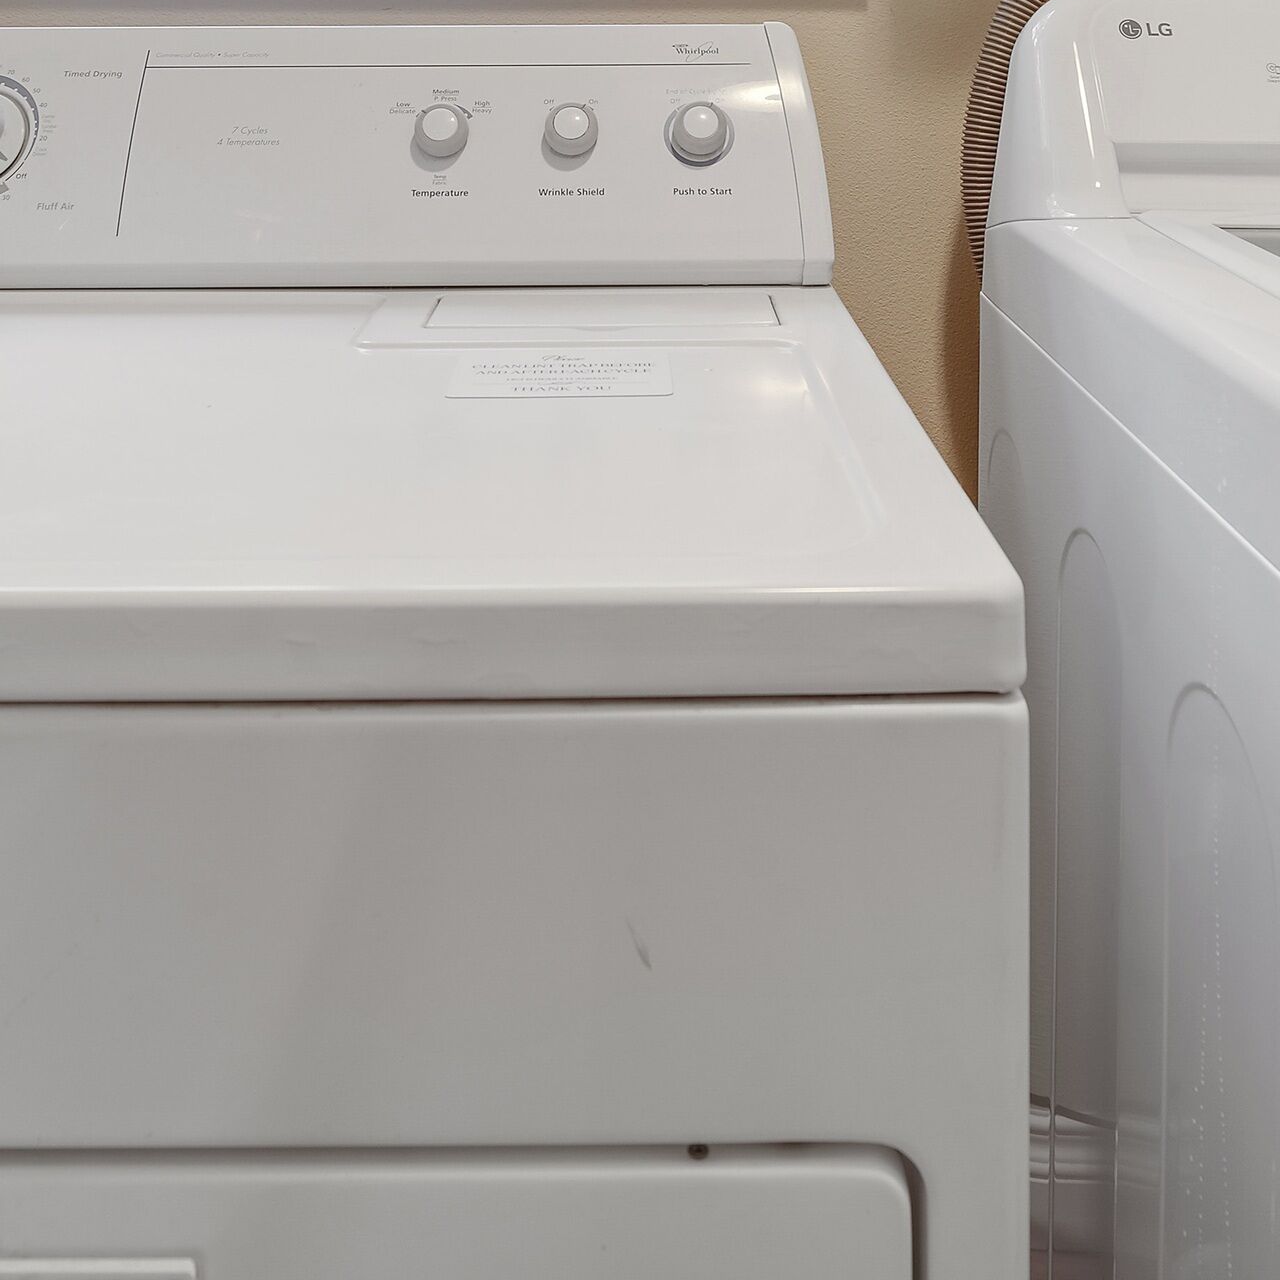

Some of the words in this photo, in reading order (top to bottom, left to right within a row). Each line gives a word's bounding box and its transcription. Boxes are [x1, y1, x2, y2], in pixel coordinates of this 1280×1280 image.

[1146, 22, 1173, 37] LG
[676, 46, 719, 56] Whirlpool
[63, 70, 91, 78] Timed
[92, 70, 123, 79] Drying
[231, 126, 239, 134] 7
[240, 126, 268, 136] Cycles
[226, 138, 280, 148] Temperatures
[411, 189, 469, 198] Temperature
[538, 188, 574, 196] Wrinkle
[577, 188, 605, 196] Shield
[673, 188, 695, 196] Push
[697, 188, 707, 196] to
[710, 188, 733, 196] Start
